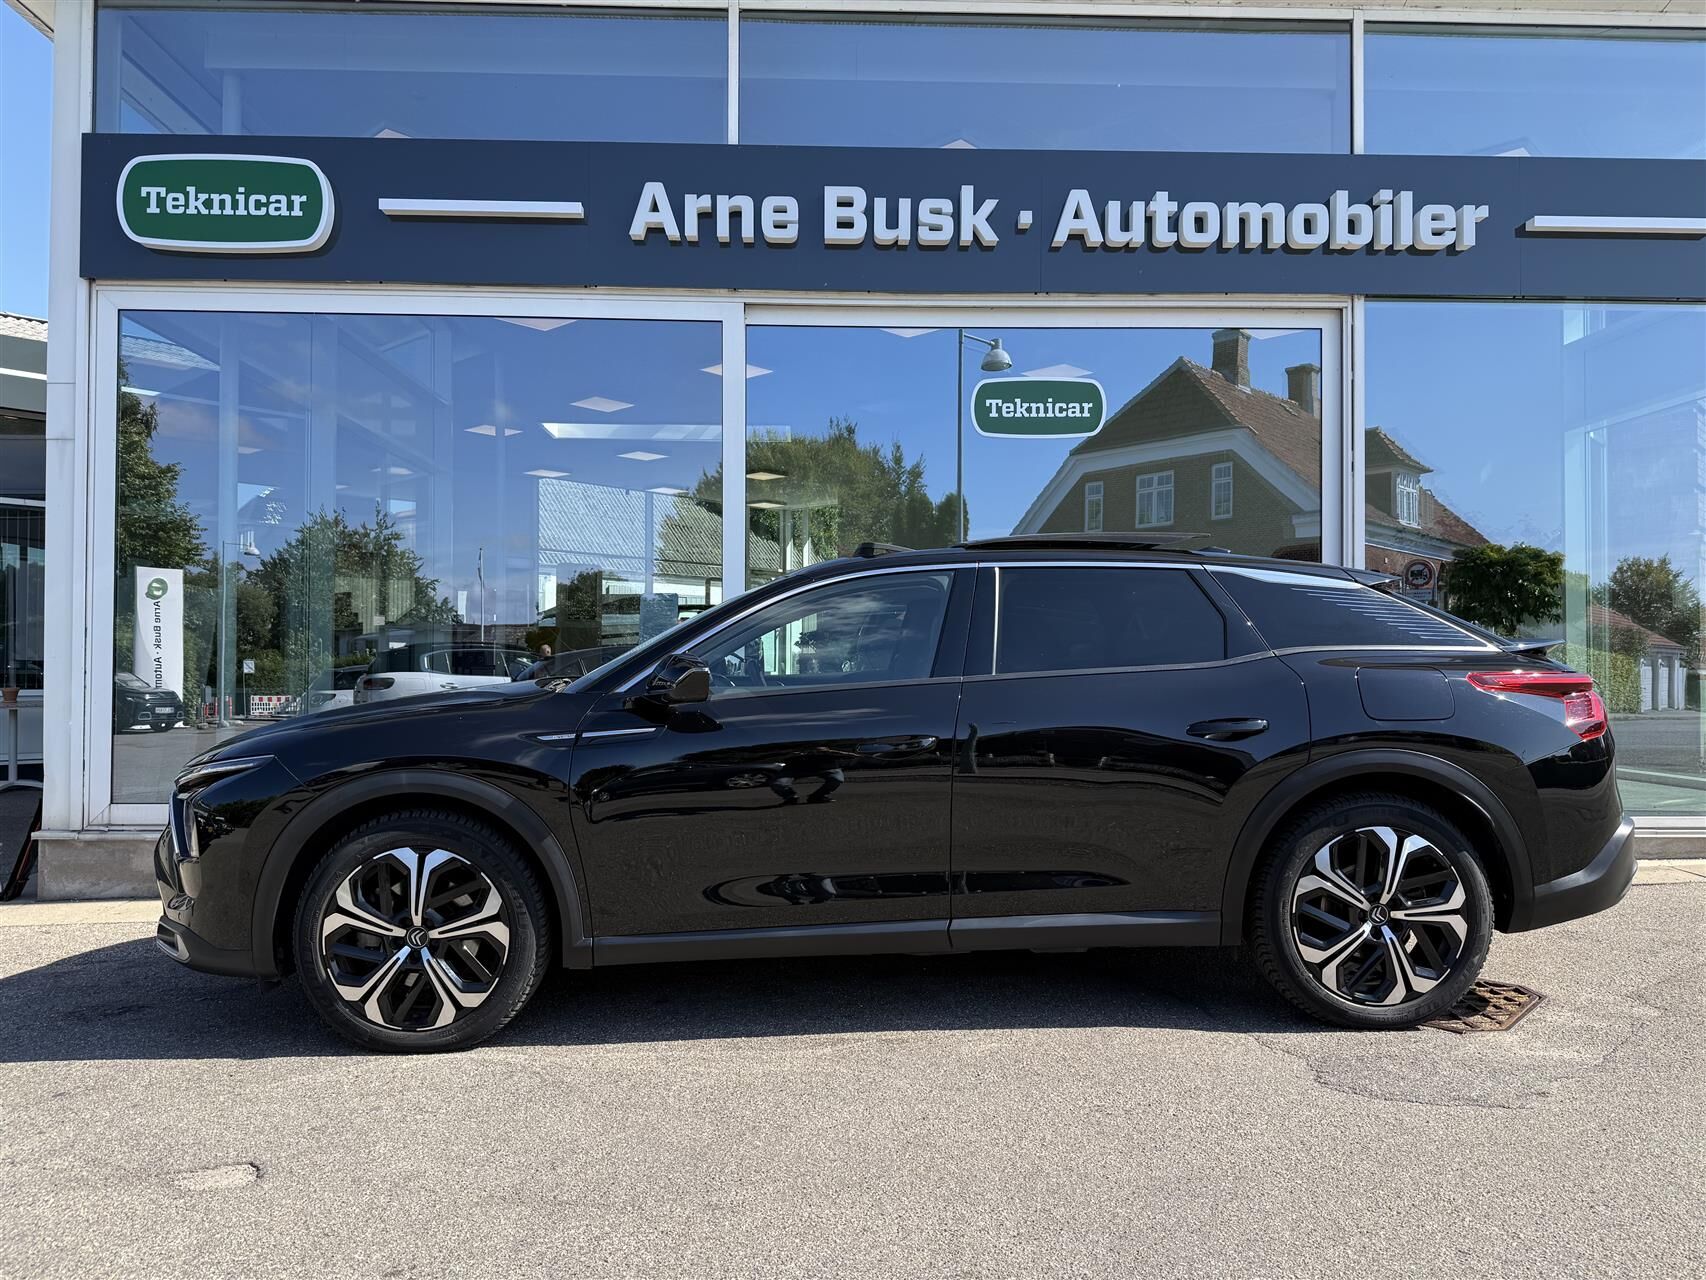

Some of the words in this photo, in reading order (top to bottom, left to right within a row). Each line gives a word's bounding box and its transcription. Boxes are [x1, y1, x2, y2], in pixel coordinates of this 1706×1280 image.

[140, 185, 307, 217] Teknicar
[629, 181, 799, 244] Arne
[824, 184, 999, 247] Busk
[1052, 188, 1489, 251] Automobiler
[985, 398, 1093, 418] Teknicar
